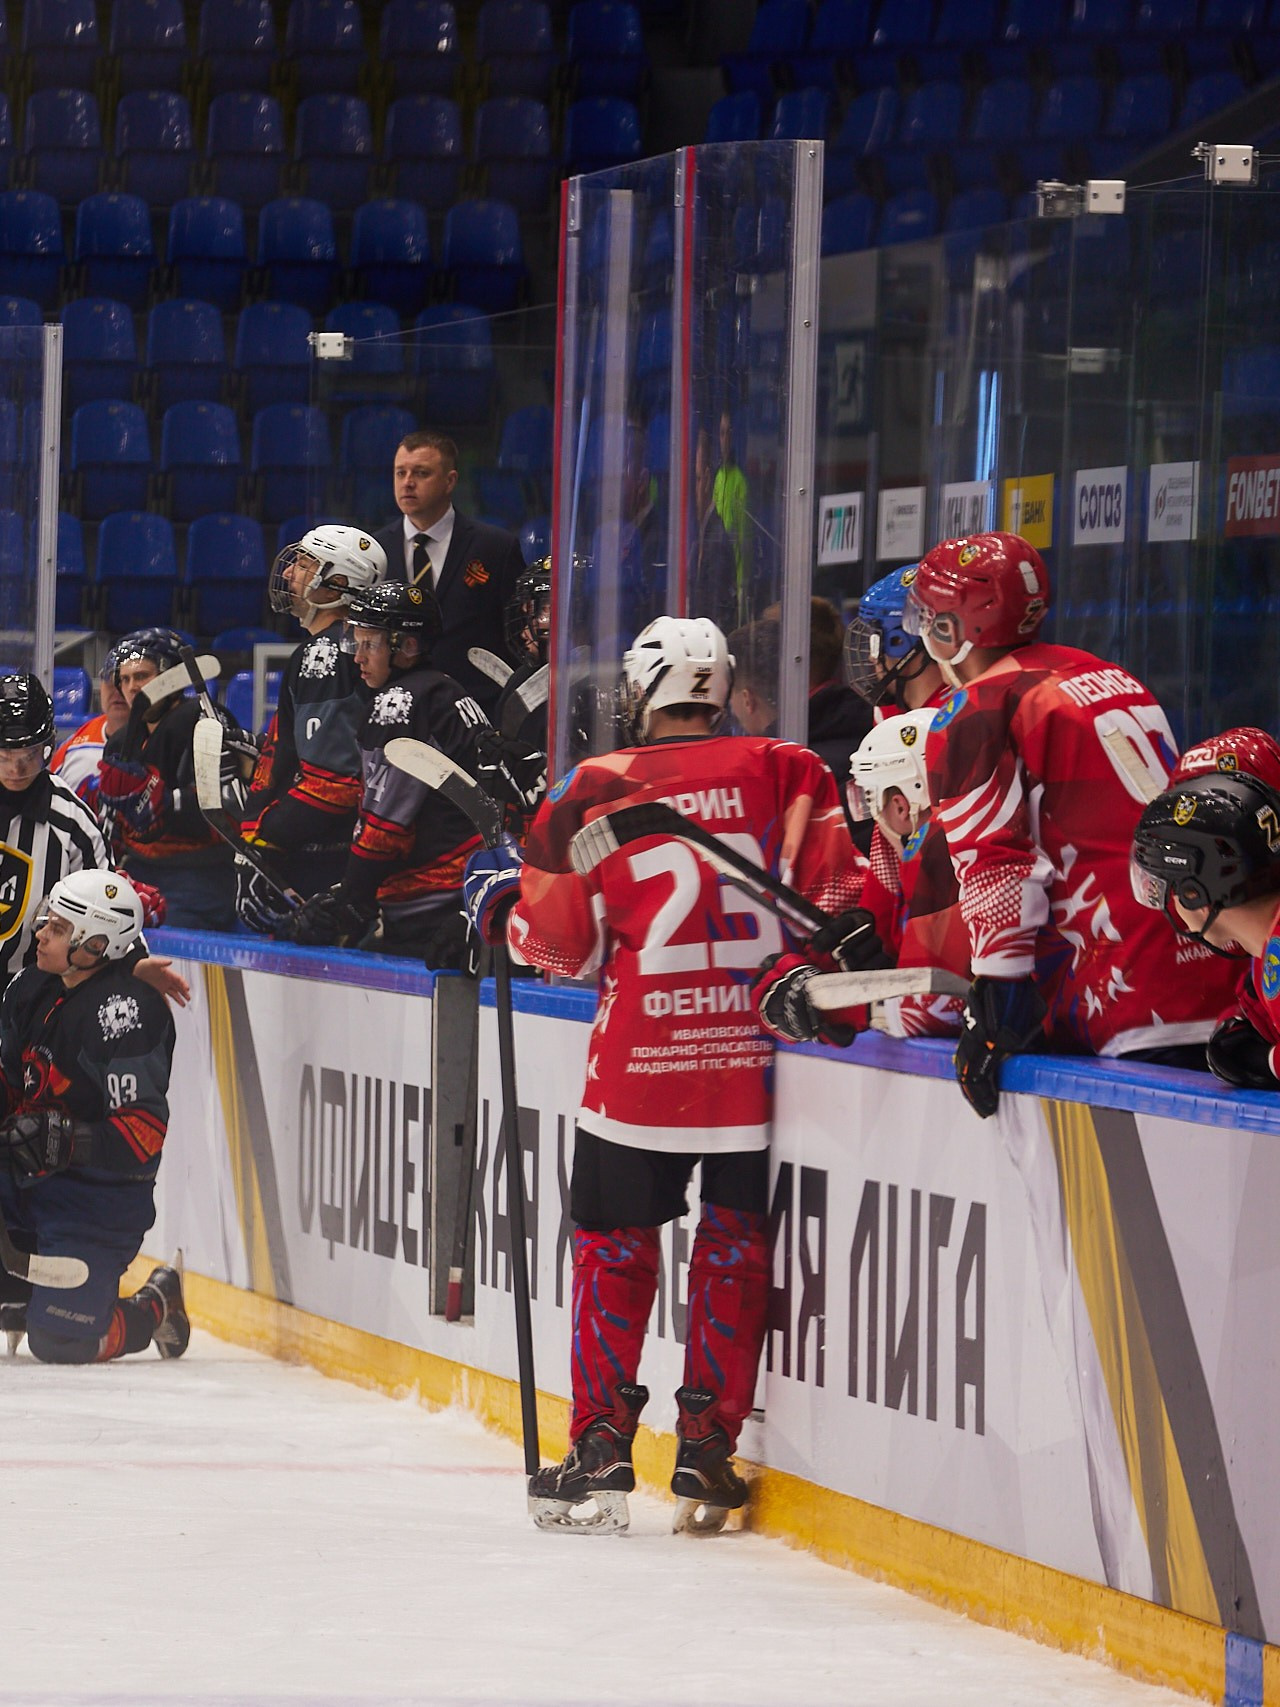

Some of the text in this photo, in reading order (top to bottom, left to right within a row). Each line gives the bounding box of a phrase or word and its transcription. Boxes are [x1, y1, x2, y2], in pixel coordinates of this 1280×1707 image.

[1226, 467, 1280, 522] FONBET
[1164, 855, 1188, 866] CCM
[1176, 939, 1237, 964] АКАДИЯ
[643, 983, 752, 1018] ФЕНИ
[671, 1025, 760, 1042] ИВАНОВСКАЯ
[631, 1041, 774, 1059] ПОЖАРНО-СПАСАТЕЛЬ
[626, 1060, 699, 1076] АКАДЕМИЯ
[700, 1058, 727, 1073] ГПС
[729, 1056, 759, 1071] МЧС
[107, 1073, 138, 1110] 93
[299, 1063, 540, 1301] ОФИЦЕКАЯ
[848, 1178, 988, 1437] ЛИГА
